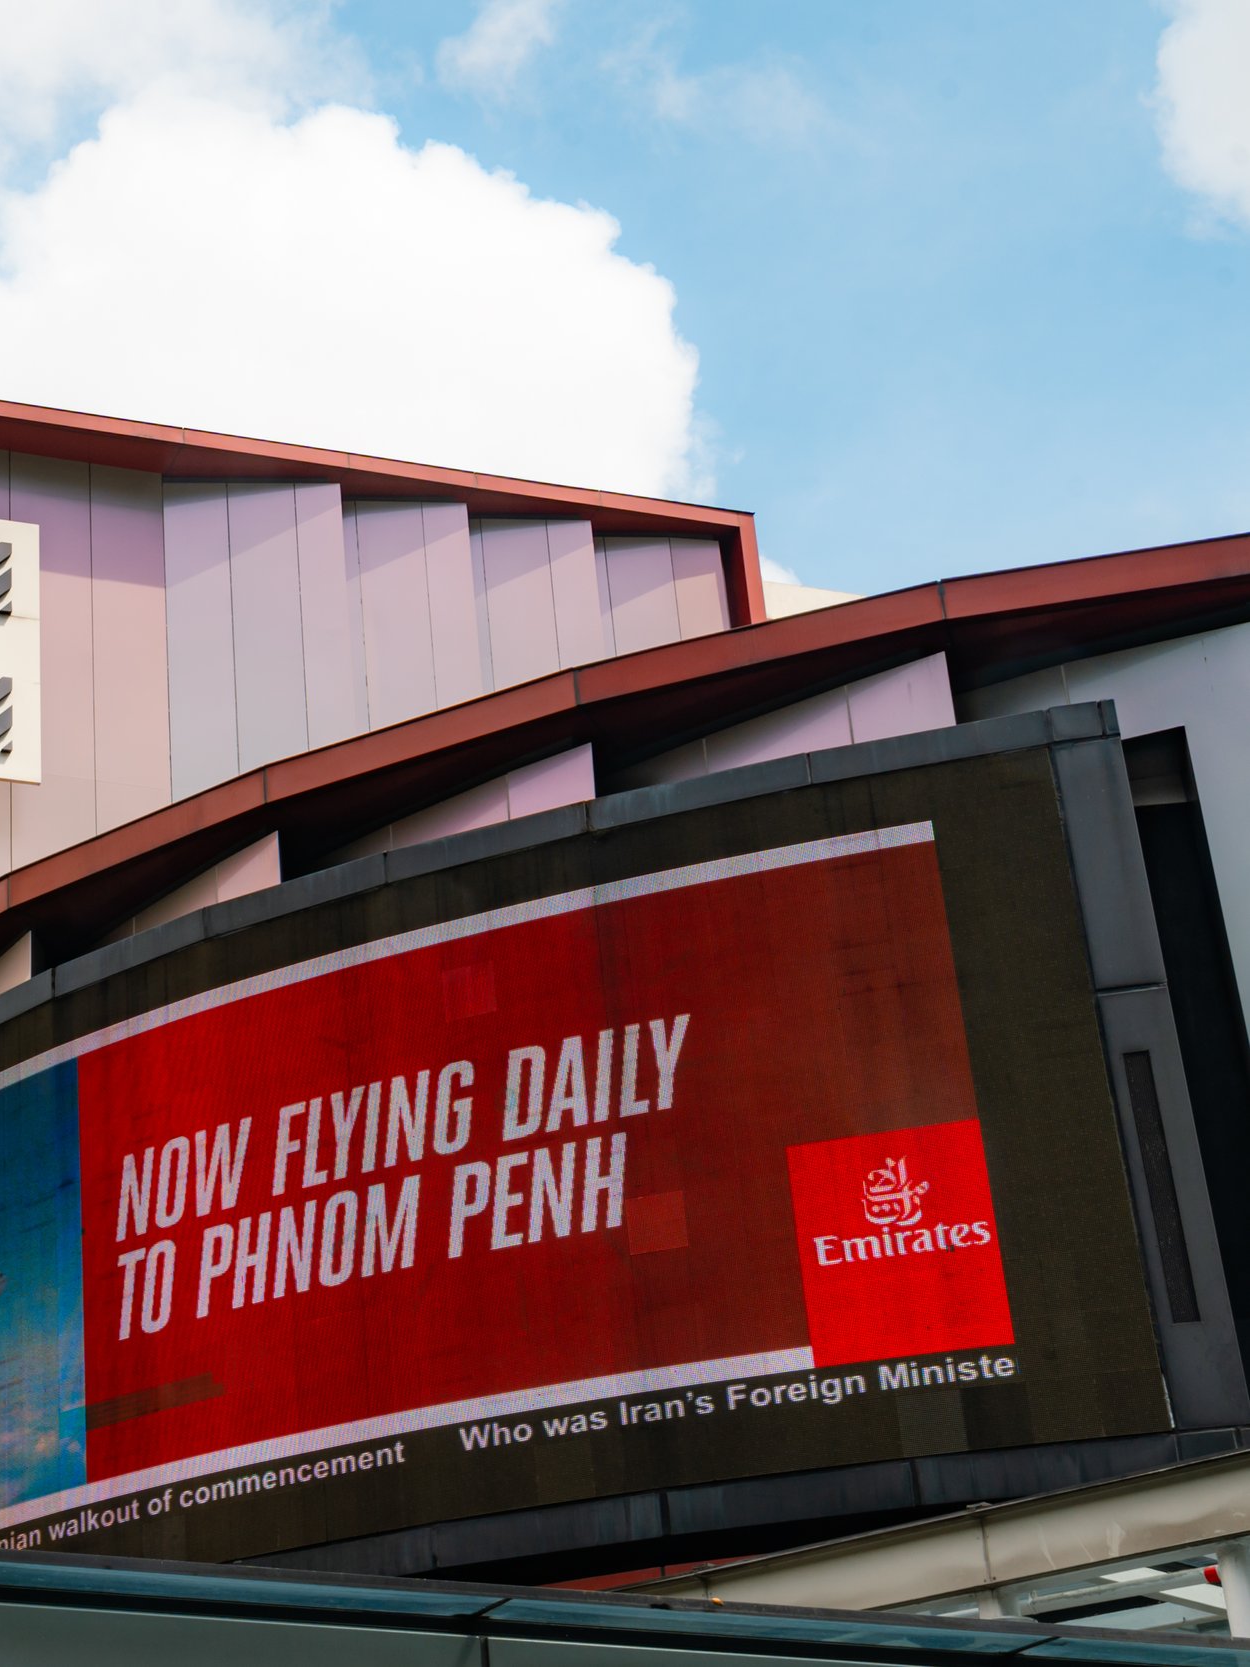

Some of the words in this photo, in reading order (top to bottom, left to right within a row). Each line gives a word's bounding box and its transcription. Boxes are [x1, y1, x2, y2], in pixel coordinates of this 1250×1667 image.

[115, 1116, 252, 1243] NOW
[272, 1059, 476, 1197] FLYING
[501, 1014, 691, 1143] DAILY
[117, 1239, 177, 1341] TO
[196, 1175, 421, 1320] PHNOM
[448, 1132, 628, 1259] PENH
[813, 1220, 992, 1267] Emirates
[48, 1498, 141, 1541] walkout
[148, 1488, 173, 1516] of
[179, 1441, 406, 1509] commencement
[459, 1419, 533, 1452] Who
[542, 1411, 609, 1438] was
[725, 1374, 867, 1413] Foreign
